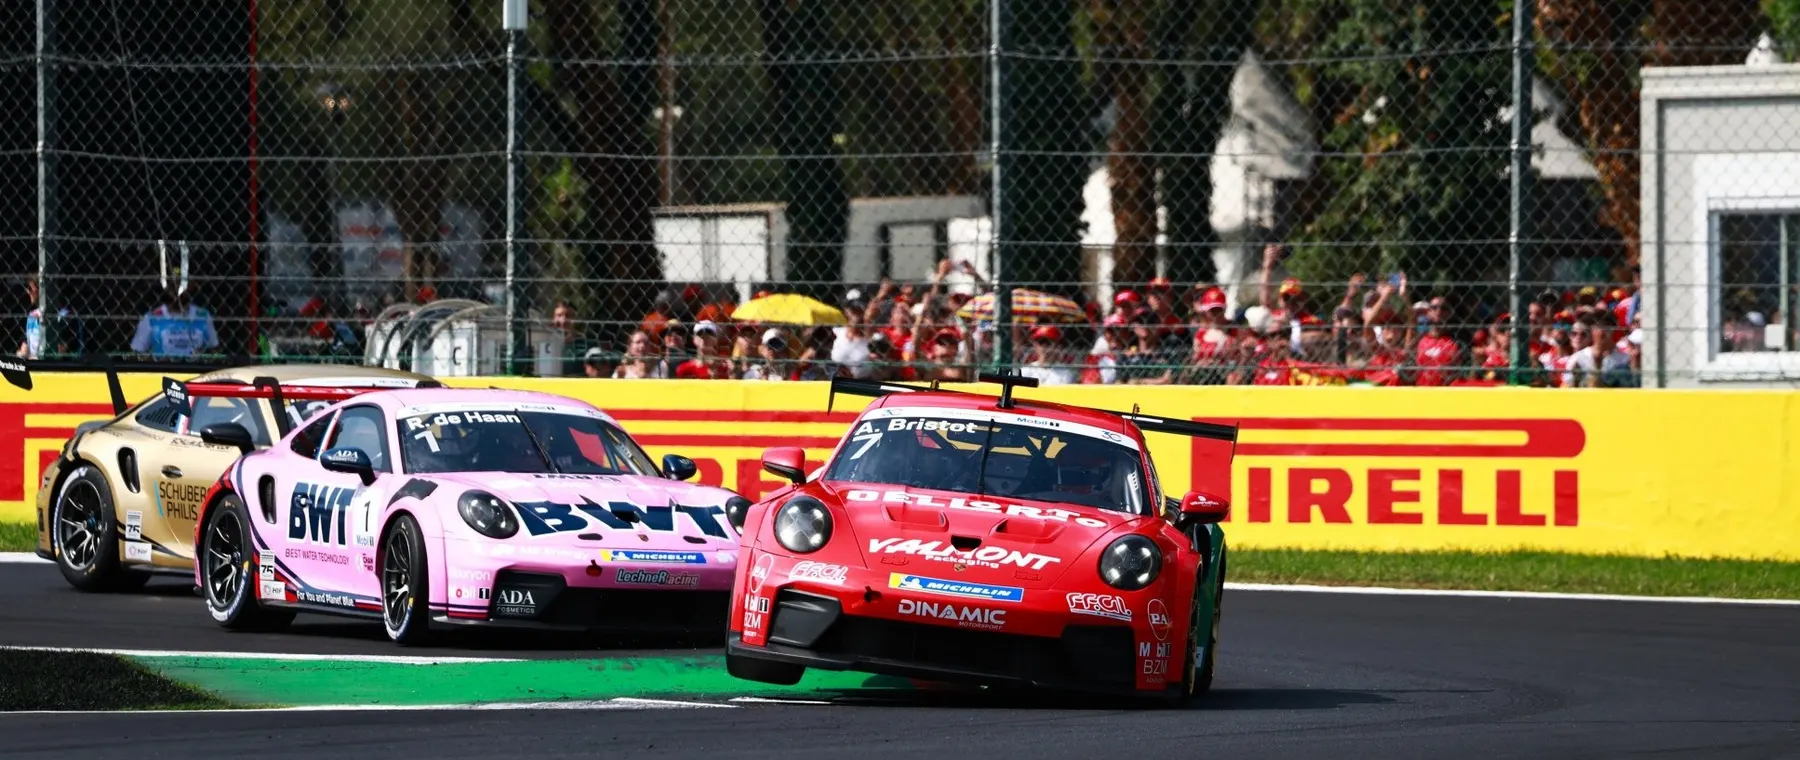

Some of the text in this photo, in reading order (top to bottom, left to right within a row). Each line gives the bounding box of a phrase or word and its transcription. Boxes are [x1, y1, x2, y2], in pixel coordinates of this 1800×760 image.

[406, 411, 521, 431] R. de Haan
[855, 418, 979, 436] A. Bristot
[414, 430, 441, 453] 1
[849, 432, 884, 460] 7
[334, 450, 359, 459] ADA
[166, 501, 199, 521] PHILIS
[288, 481, 357, 546] BWT
[363, 500, 372, 533] 1
[508, 494, 731, 540] BWT
[285, 548, 301, 558] BEST
[302, 550, 318, 561] WATER
[318, 552, 350, 566] TECHNOLOGY
[632, 552, 697, 561] MICHELIN
[868, 537, 1061, 571] VALMONT
[925, 554, 1000, 569] Packaging
[498, 588, 536, 606] ADA
[926, 582, 1012, 597] MICHELIN
[898, 599, 1007, 625] DINAMIC
[1150, 613, 1169, 625] PA
[958, 621, 1004, 631] MOTORSPORT
[1143, 659, 1168, 674] BZM
